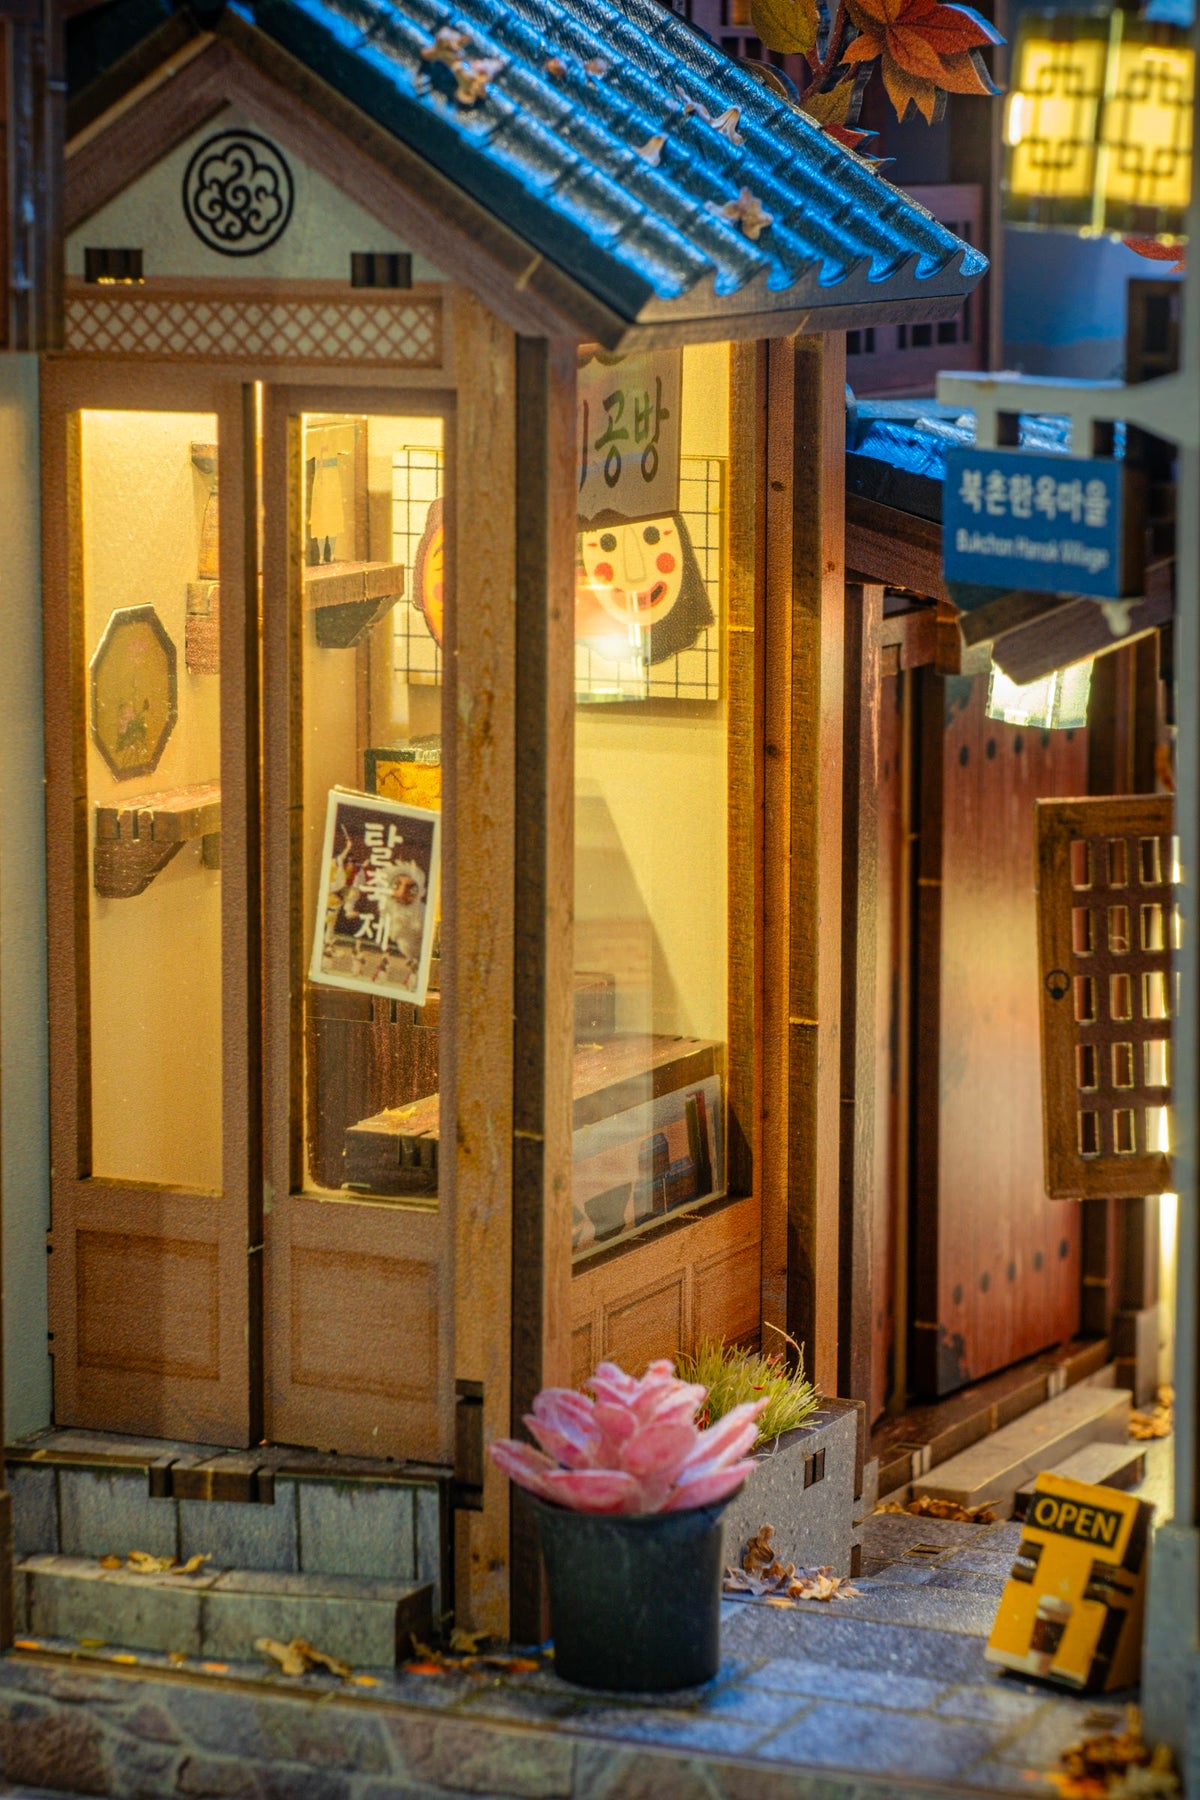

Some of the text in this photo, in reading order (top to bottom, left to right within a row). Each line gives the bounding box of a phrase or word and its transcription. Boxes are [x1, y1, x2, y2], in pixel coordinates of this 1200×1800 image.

[958, 468, 1111, 528] 북촌한옥마을
[1059, 539, 1110, 574] Village
[1034, 1497, 1117, 1543] OPEN
